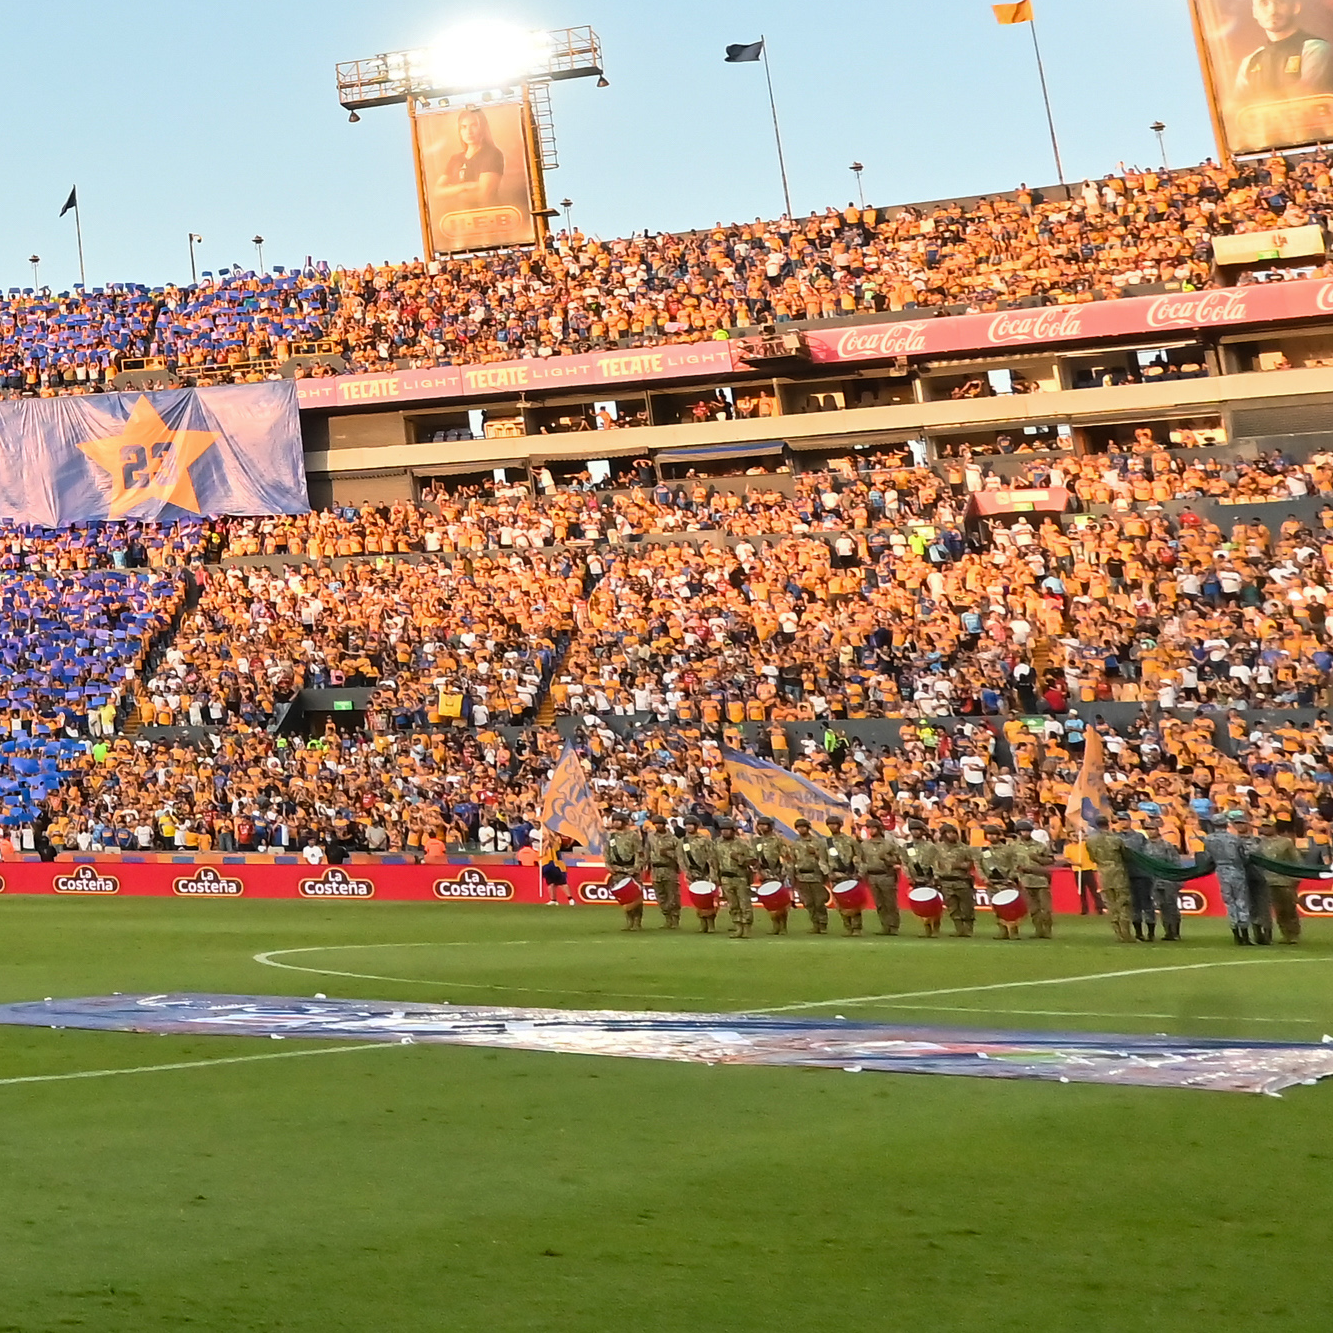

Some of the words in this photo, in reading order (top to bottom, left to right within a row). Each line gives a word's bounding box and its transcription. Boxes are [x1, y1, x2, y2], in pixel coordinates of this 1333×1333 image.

[1147, 290, 1248, 327] Coca-Cola
[988, 306, 1084, 343] Coca-Cola
[838, 323, 928, 358] Coca-Cola
[597, 354, 664, 377] TECATE
[668, 351, 729, 366] LIGHT
[465, 366, 528, 388] TECATE
[532, 365, 590, 379] LIGHT
[339, 378, 399, 400] TECATE
[404, 377, 459, 390] LIGHT
[79, 868, 92, 878] La
[201, 870, 214, 880] La
[328, 870, 342, 881] La
[465, 872, 479, 882] La
[57, 876, 114, 891] Costeña
[178, 879, 237, 893] Costeña
[304, 880, 368, 895] Costeña
[439, 881, 507, 897] Costeña
